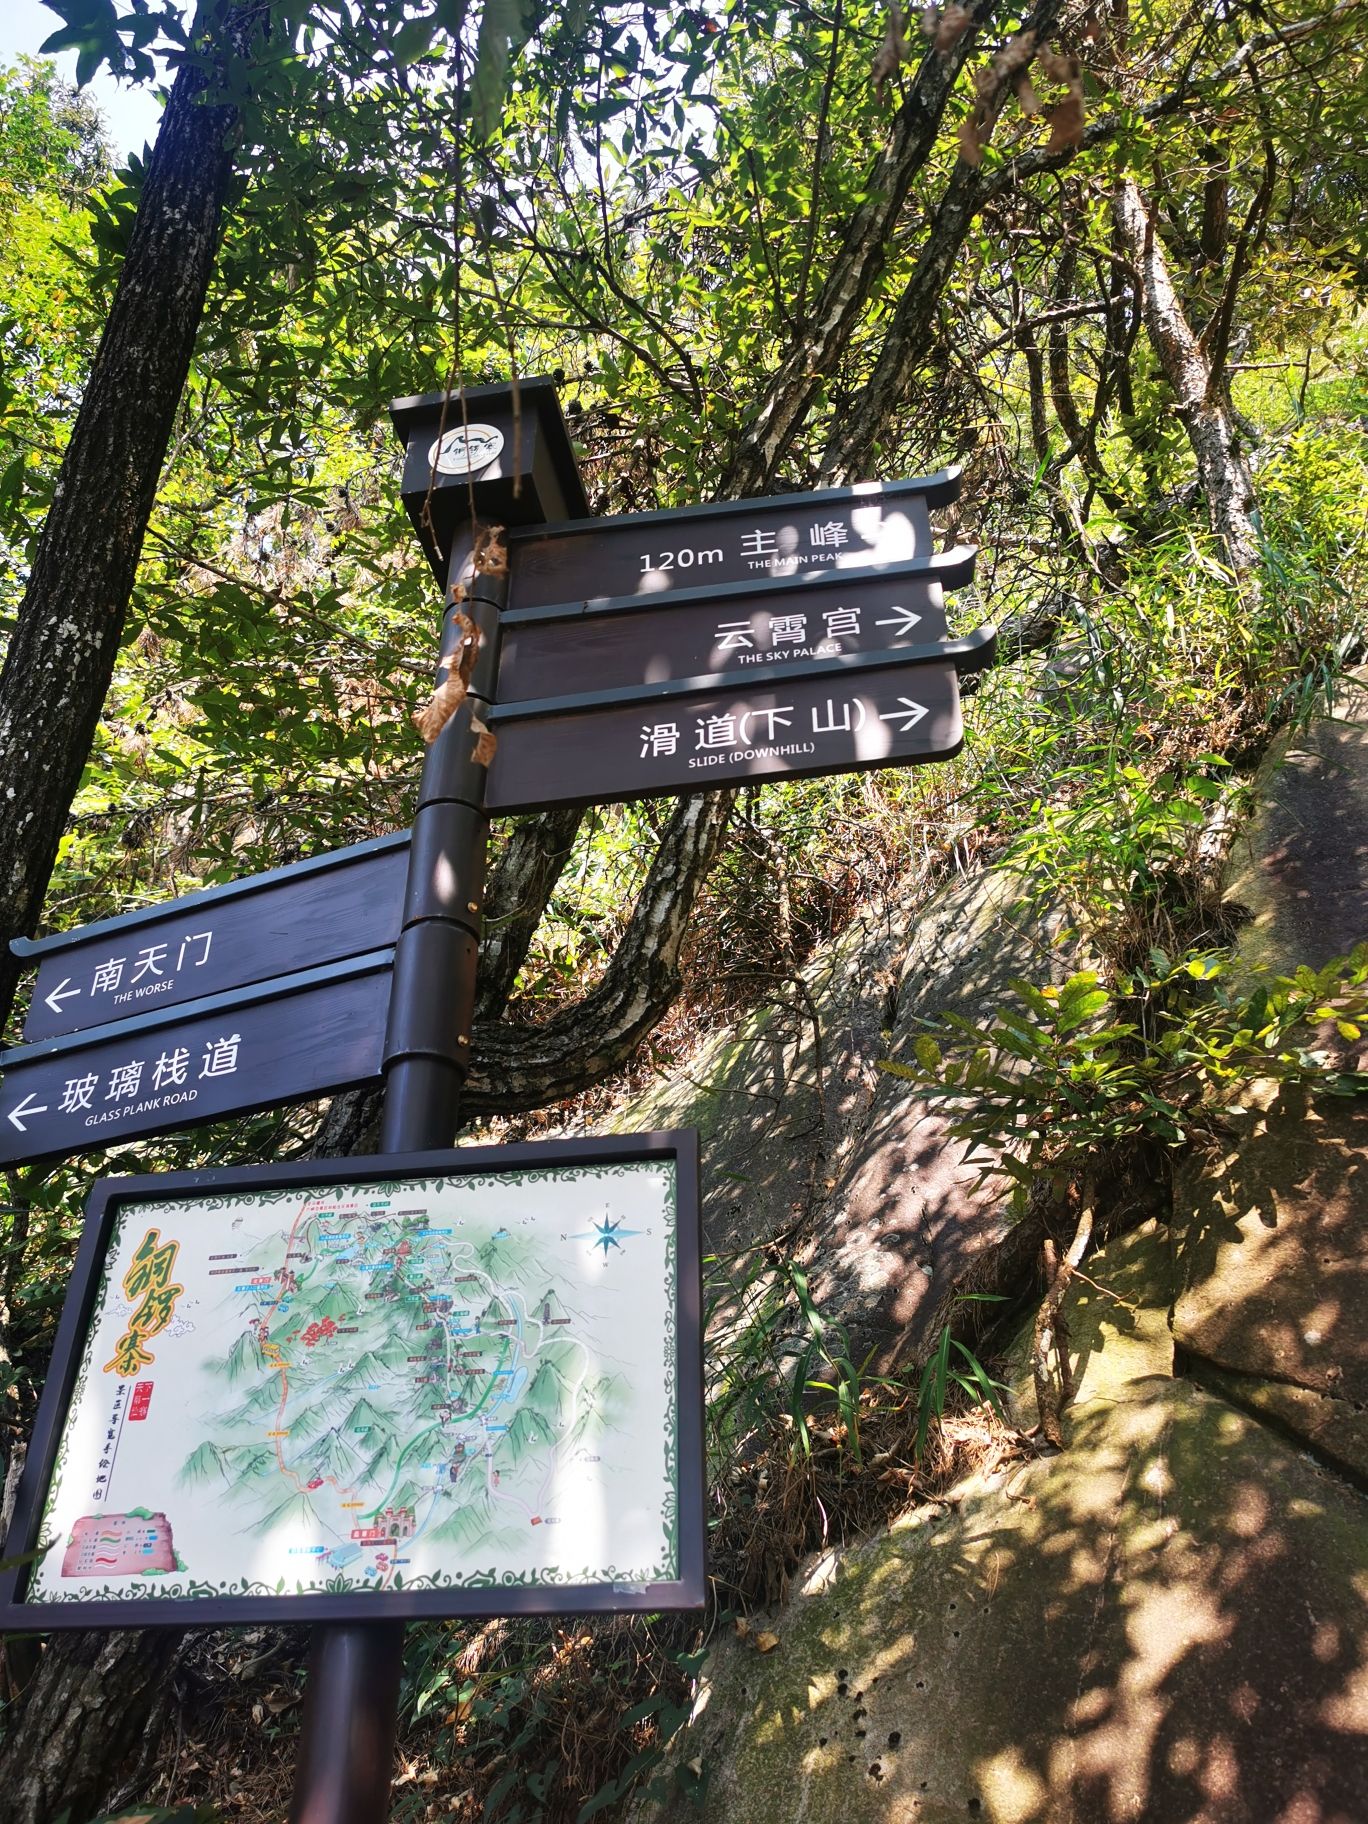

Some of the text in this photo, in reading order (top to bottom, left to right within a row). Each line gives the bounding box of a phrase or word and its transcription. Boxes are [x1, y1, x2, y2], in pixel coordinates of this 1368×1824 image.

[640, 521, 849, 573] 120m 主峰
[748, 551, 844, 570] THE MAIN PEAK
[714, 607, 861, 650] 云霄宫
[738, 642, 843, 665] THE SKY PALACE
[688, 742, 816, 769] SLIDE (DOWNHILL)
[90, 931, 213, 997] 南天门
[113, 979, 175, 1005] THE WORSE
[57, 1033, 242, 1114] 玻璃栈道
[84, 1089, 199, 1127] GLASS PLANK ROAD
